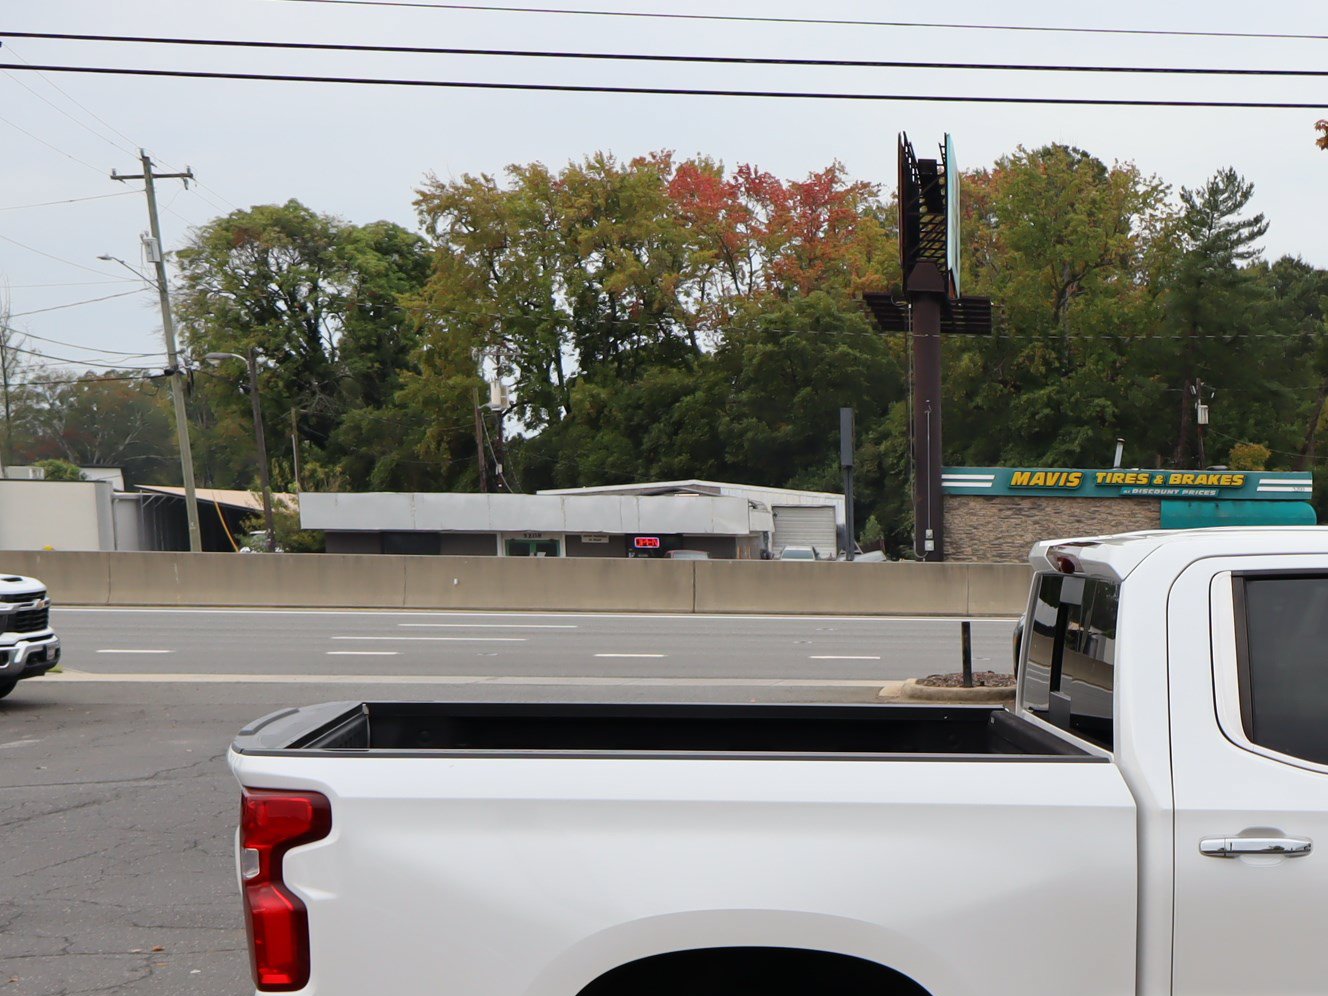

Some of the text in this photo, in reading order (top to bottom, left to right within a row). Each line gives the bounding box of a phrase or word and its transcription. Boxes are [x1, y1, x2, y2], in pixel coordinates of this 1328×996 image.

[1009, 471, 1245, 487] MAVIS TIRES & BRAKES
[1132, 488, 1180, 496] DISCOUNT
